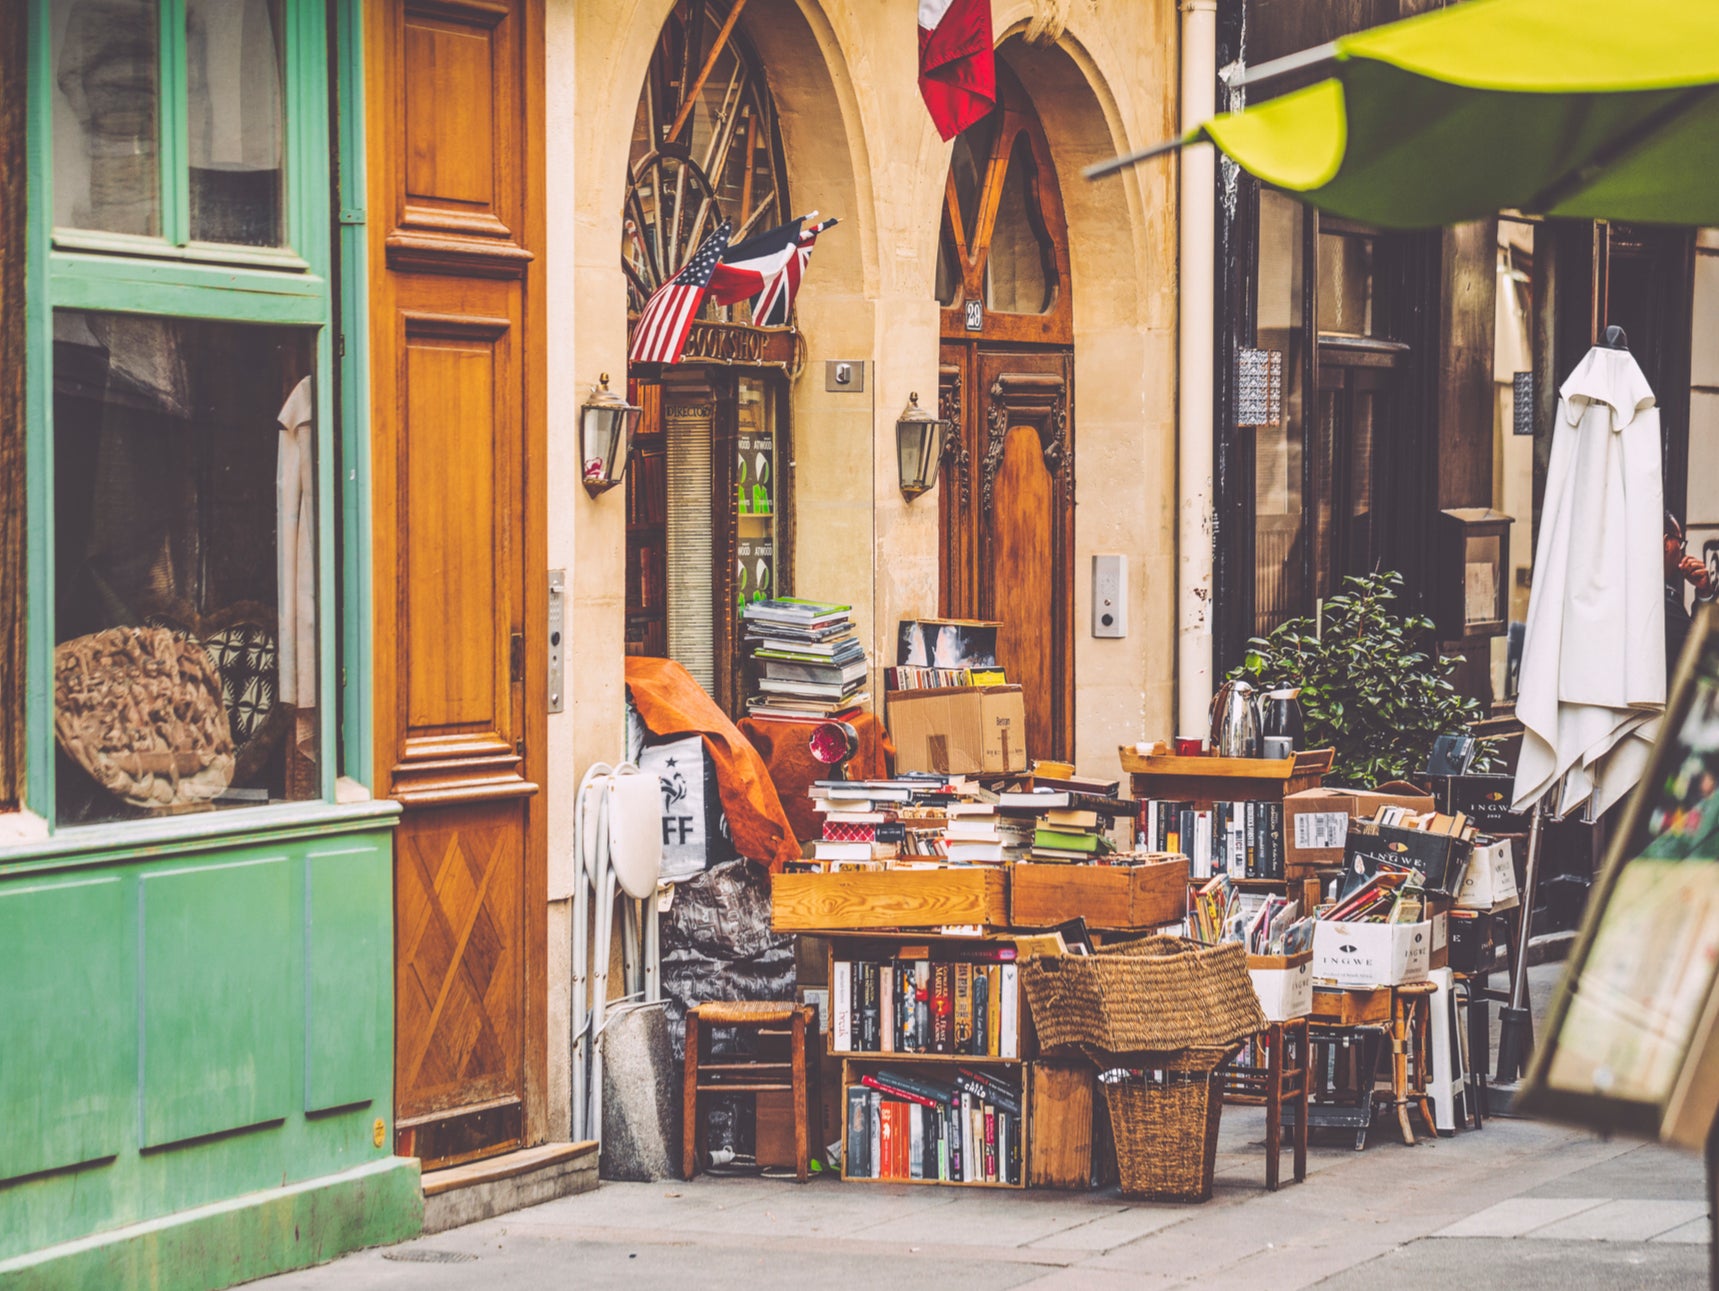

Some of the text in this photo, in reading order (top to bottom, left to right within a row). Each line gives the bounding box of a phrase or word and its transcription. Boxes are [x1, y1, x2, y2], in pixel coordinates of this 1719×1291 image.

[1470, 804, 1509, 812] INGW
[661, 816, 693, 845] FF
[1323, 957, 1373, 966] INGWE
[964, 1082, 986, 1099] CHILD
[971, 1081, 984, 1092] LEE
